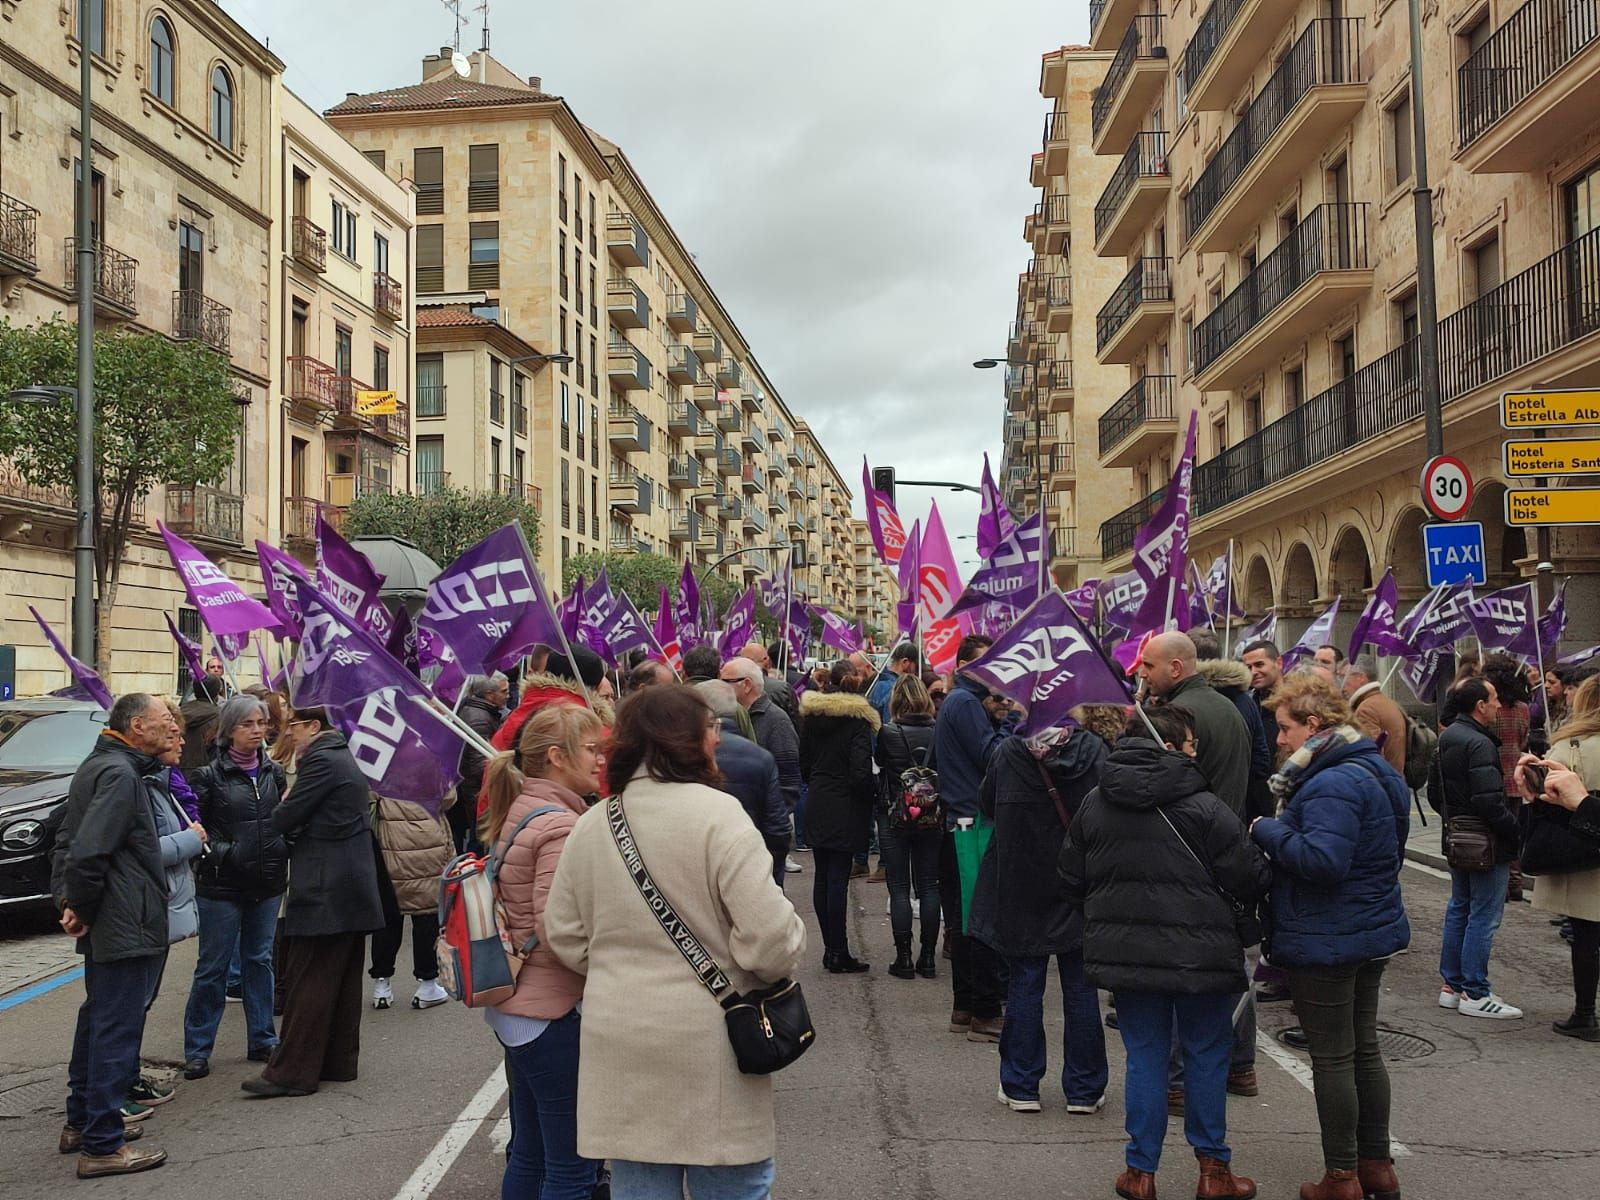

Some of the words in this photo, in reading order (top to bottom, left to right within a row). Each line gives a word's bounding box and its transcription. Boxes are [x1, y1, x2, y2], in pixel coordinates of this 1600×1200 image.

[1508, 398, 1546, 409] hotel
[1509, 410, 1566, 422] Estrella
[1511, 447, 1544, 457] hotel
[1435, 476, 1462, 498] 30
[1513, 495, 1550, 507] hotel
[1513, 508, 1538, 520] Ibis
[1429, 545, 1480, 566] TAXI
[196, 590, 247, 608] Castilla
[4, 686, 10, 697] P
